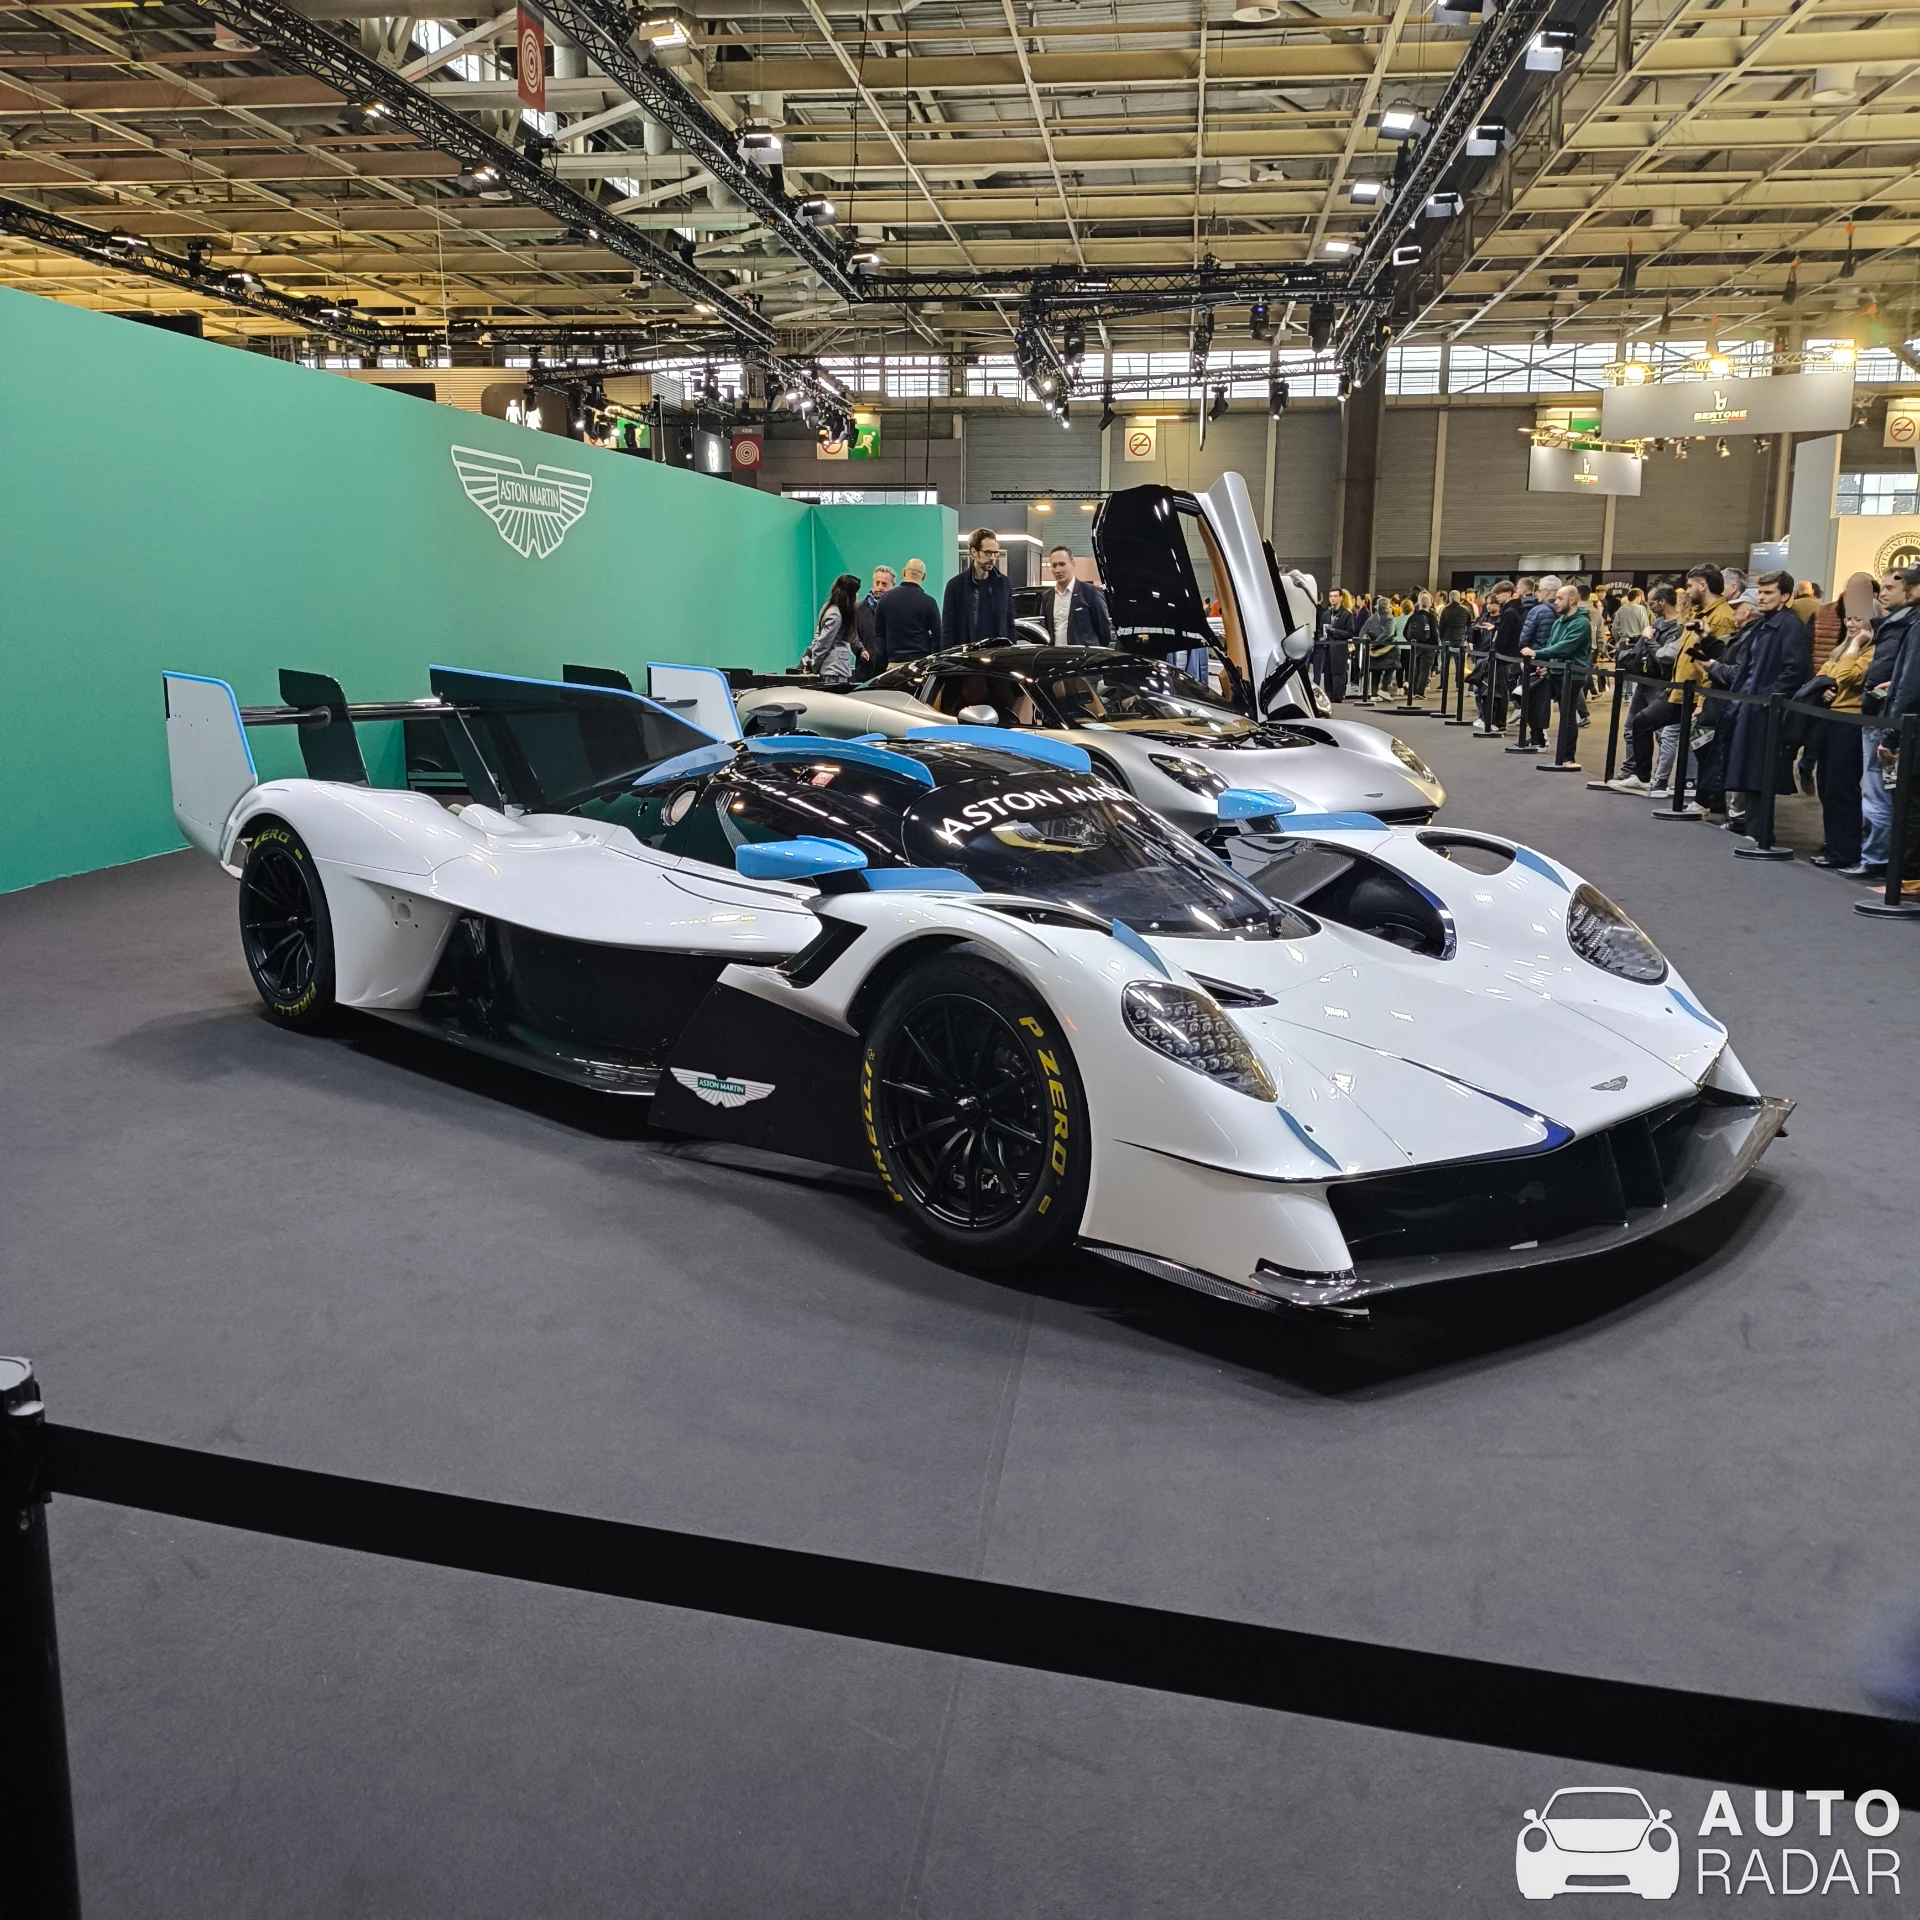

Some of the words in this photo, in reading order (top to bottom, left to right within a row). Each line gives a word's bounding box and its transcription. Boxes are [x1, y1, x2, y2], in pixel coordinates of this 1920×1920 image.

[1693, 409, 1748, 421] BERTONE
[500, 480, 528, 503] ASTON
[529, 486, 559, 508] MARTIN
[935, 789, 1063, 847] ASTON
[253, 828, 291, 849] ZERO
[698, 1079, 720, 1089] ASTON
[719, 1081, 744, 1093] MARTIN
[1018, 1015, 1044, 1037] P
[1037, 1048, 1069, 1177] ZERO
